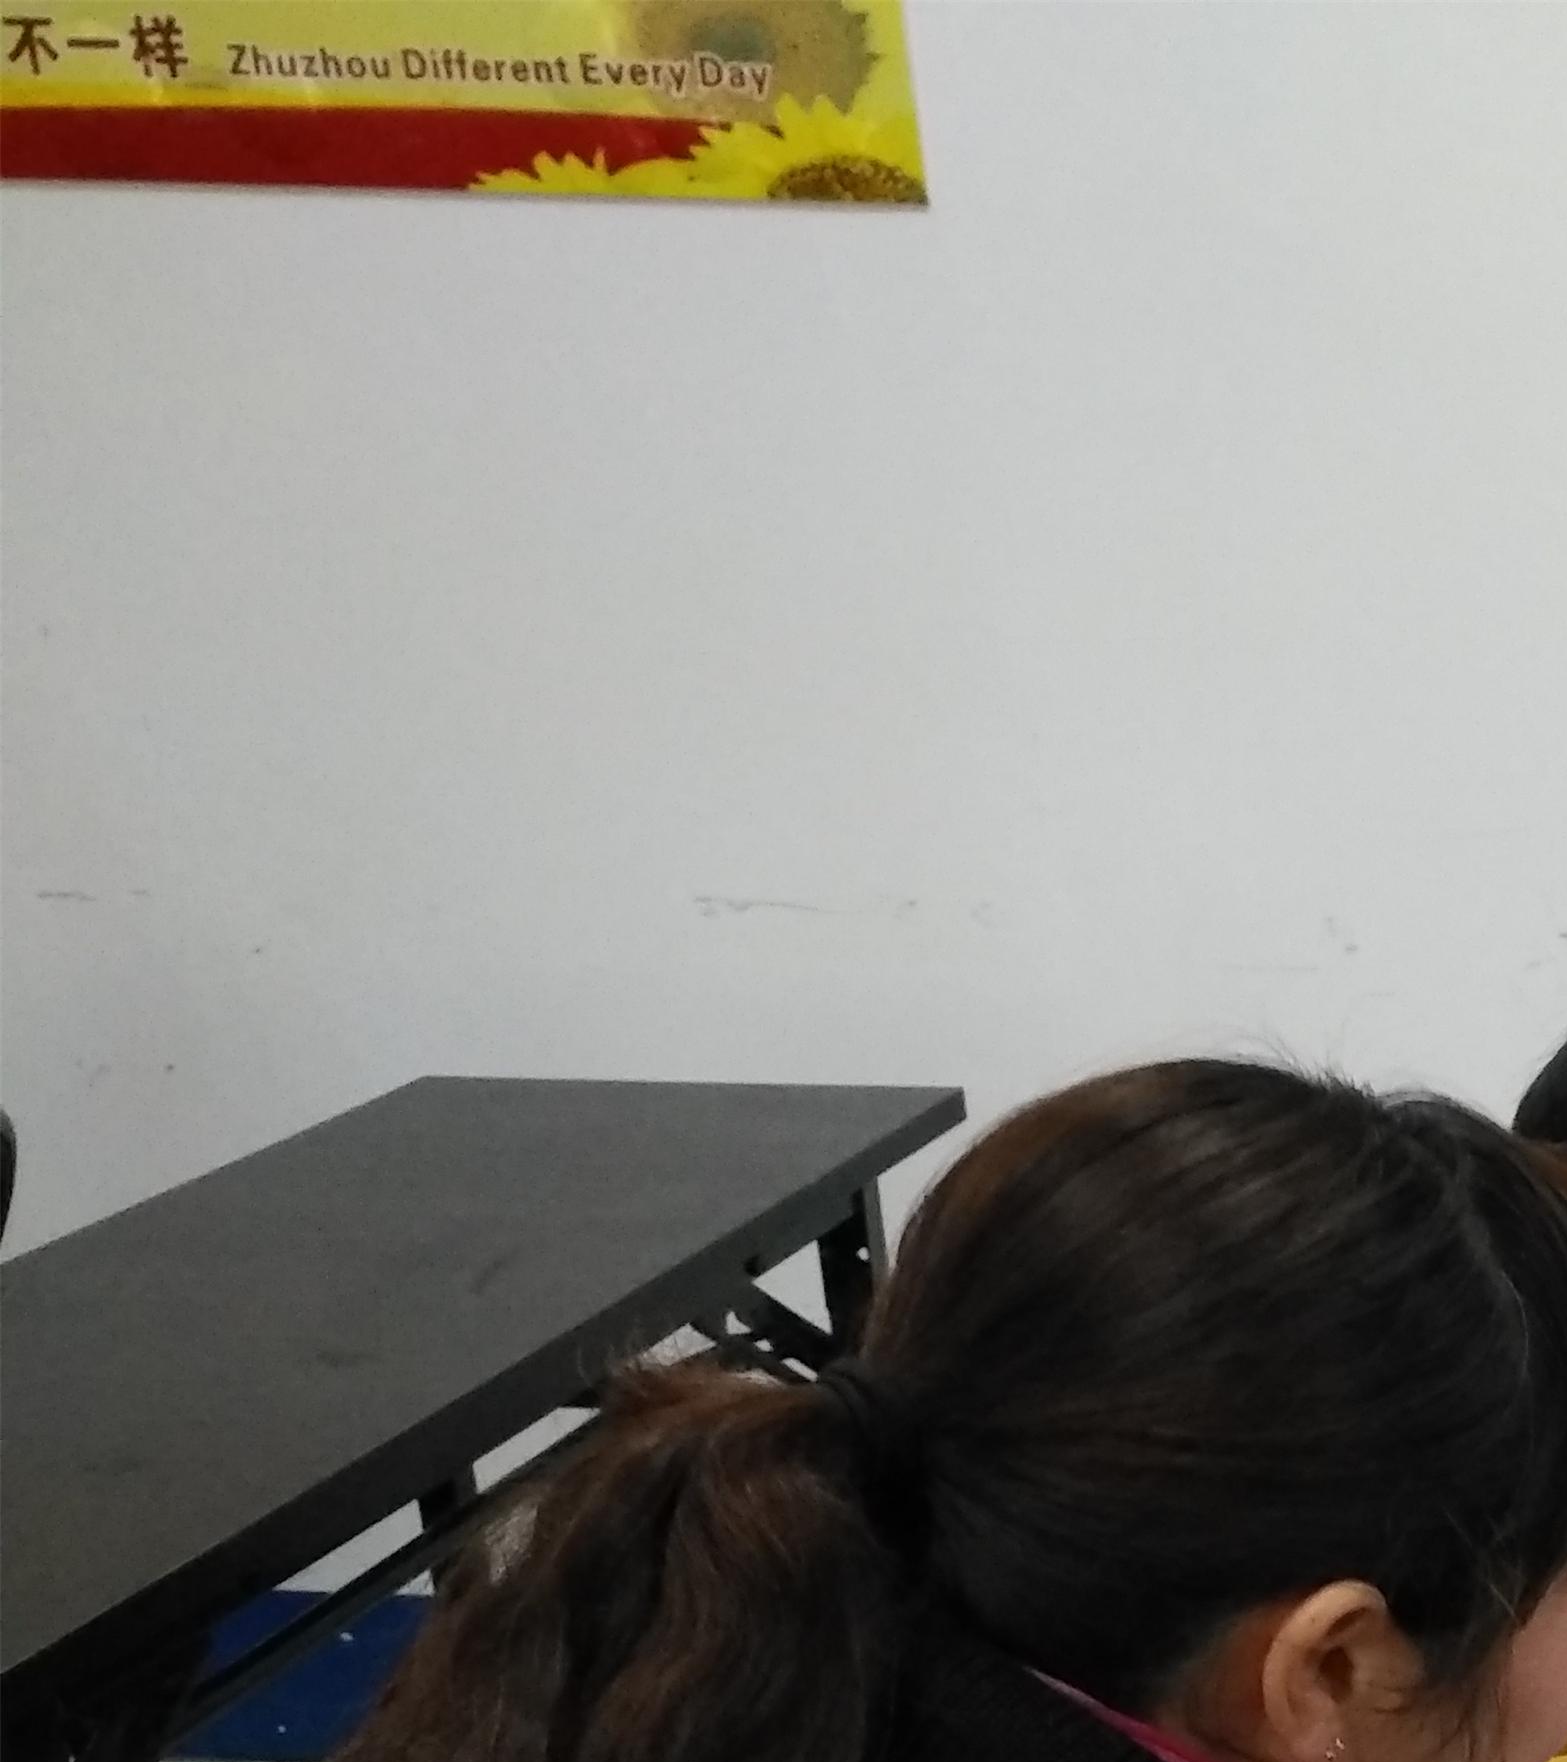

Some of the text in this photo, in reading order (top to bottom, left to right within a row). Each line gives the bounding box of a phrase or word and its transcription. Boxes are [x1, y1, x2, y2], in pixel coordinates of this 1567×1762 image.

[2, 14, 189, 78] 不一样
[226, 43, 769, 95] Zhuzhou Different Every Day
